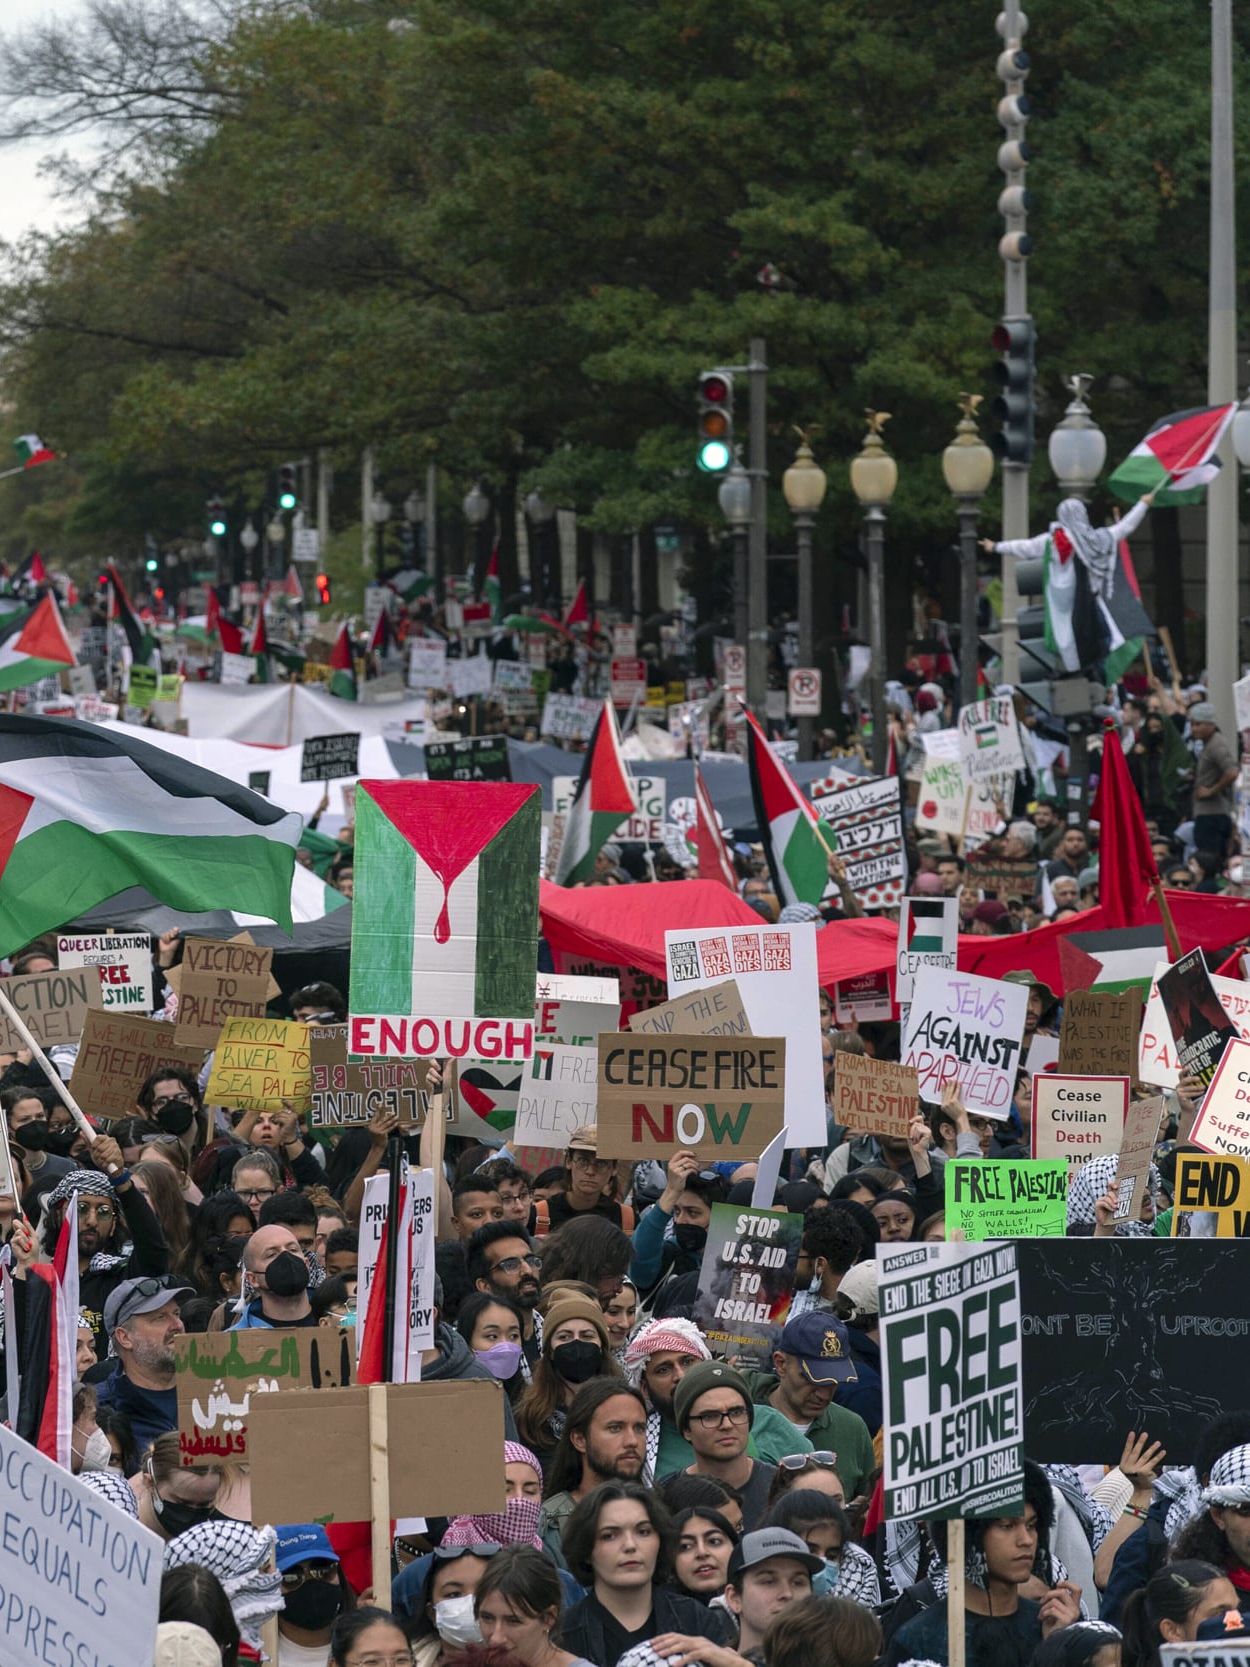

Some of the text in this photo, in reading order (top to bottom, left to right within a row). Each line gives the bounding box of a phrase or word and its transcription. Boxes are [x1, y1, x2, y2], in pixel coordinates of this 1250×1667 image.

[850, 855, 900, 878] WITH THE
[59, 936, 150, 951] QUEER LIBERATION
[764, 949, 790, 960] GAZA
[186, 946, 268, 976] VICTORY
[703, 953, 728, 968] GAZA
[734, 950, 760, 962] GAZA
[735, 960, 761, 972] DIES
[764, 959, 791, 971] DIES
[673, 963, 700, 981] GAZA
[705, 963, 731, 978] DIES
[216, 977, 237, 997] TO
[684, 992, 728, 1021] THE
[946, 981, 1006, 1029] JEWS
[1070, 1001, 1127, 1019] WHAT IF
[226, 1021, 288, 1044] FROM
[351, 1016, 533, 1060] ENOUGH
[908, 1010, 1020, 1071] AGAINST
[1065, 1022, 1131, 1042] PALESTINE
[82, 1043, 136, 1076] FREE
[222, 1046, 279, 1070] RIVER
[837, 1052, 868, 1071] FROM
[217, 1071, 252, 1095] SEA
[313, 1064, 418, 1090] WILL BE
[836, 1072, 904, 1095] TO THE SEA
[904, 1050, 1010, 1108] APARTHEID
[1057, 1088, 1102, 1102] Cease
[632, 1103, 753, 1145] NOW
[837, 1109, 870, 1131] WILL
[1051, 1109, 1108, 1124] Civilian
[1056, 1130, 1102, 1144] Death
[1065, 1152, 1093, 1165] and
[954, 1166, 1067, 1203] FREE PALESTINE
[1179, 1160, 1241, 1208] END
[960, 1209, 974, 1219] NO
[985, 1217, 1028, 1228] WALLS!
[735, 1214, 781, 1238] STOP
[722, 1243, 787, 1267] U.S. AID
[885, 1251, 926, 1272] ANSWER
[739, 1272, 762, 1296] TO
[884, 1253, 996, 1314] END THE SIEGE GAZA
[714, 1297, 773, 1325] ISRAEL
[1075, 1314, 1116, 1336] BE
[886, 1280, 1018, 1427] FREE
[890, 1387, 1019, 1482] PALESTINE!
[893, 1446, 1021, 1516] END ALL U.S. ISRAEL
[2, 1511, 107, 1617] EQUALS
